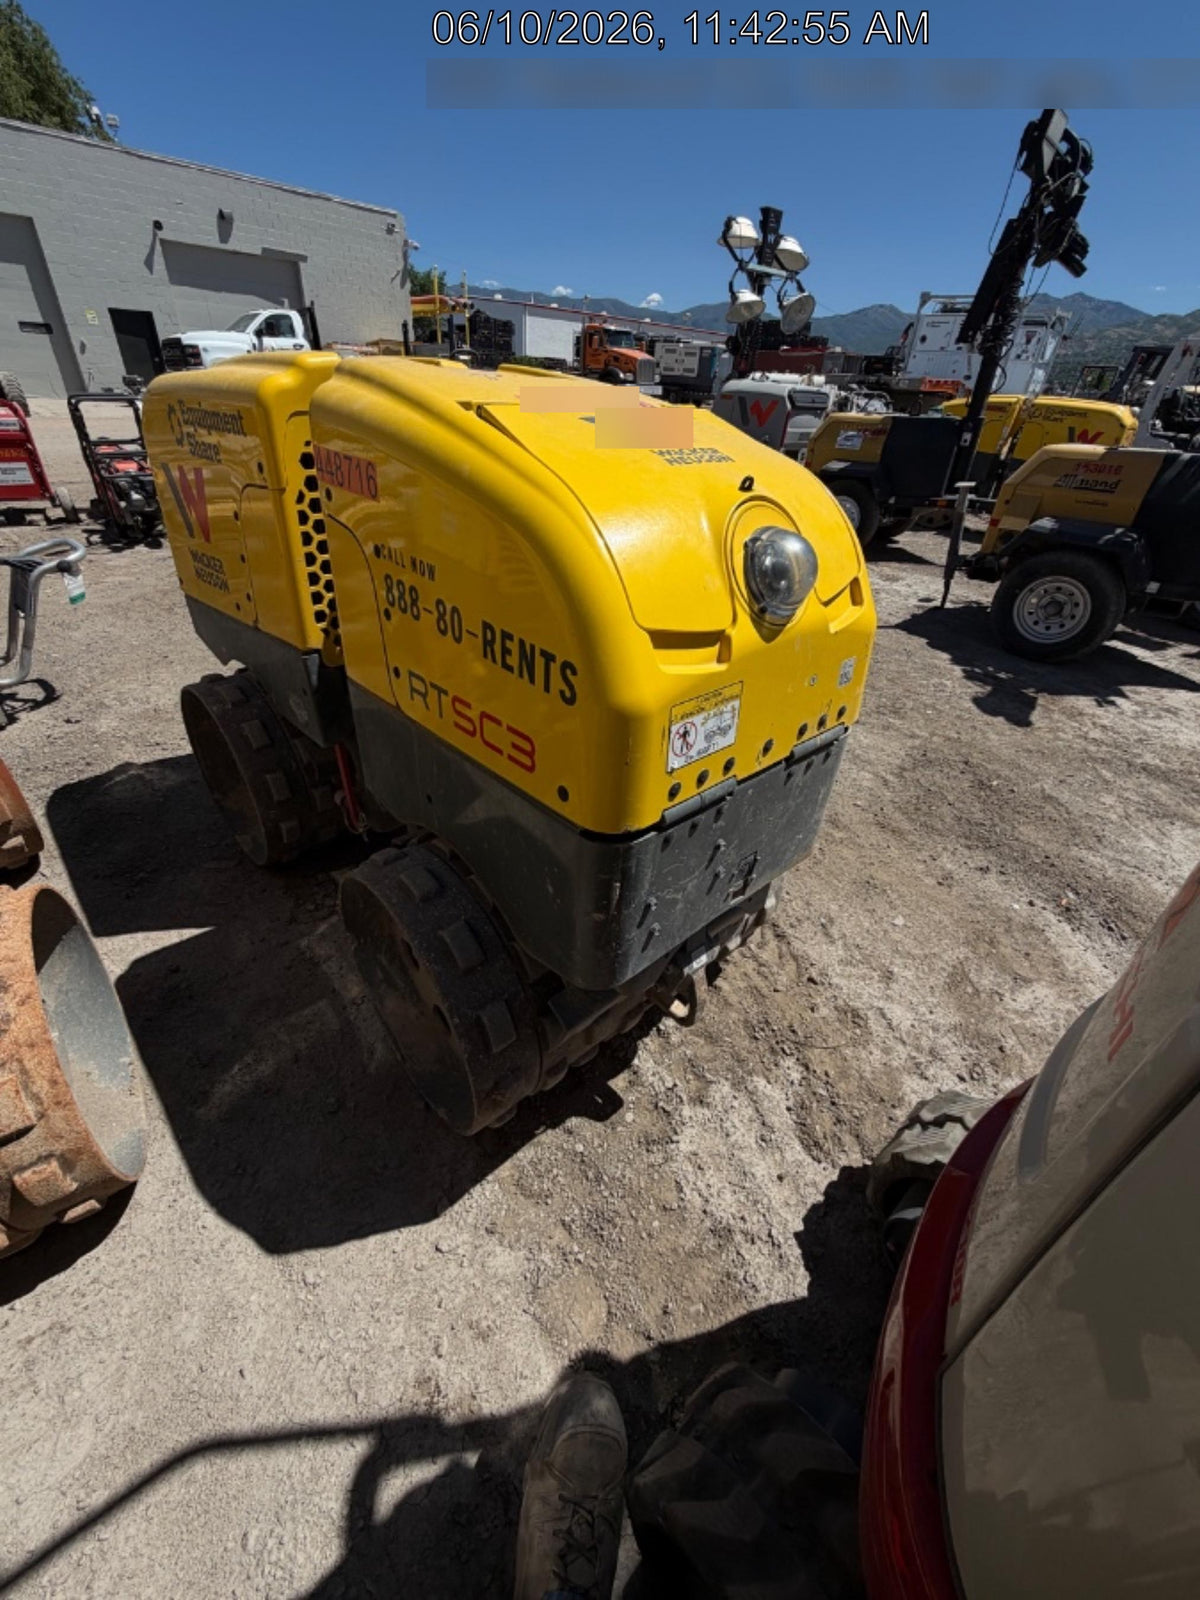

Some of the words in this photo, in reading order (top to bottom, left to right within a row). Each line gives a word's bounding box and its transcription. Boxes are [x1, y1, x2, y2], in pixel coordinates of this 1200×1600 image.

[179, 400, 246, 437] Equipment
[187, 431, 222, 464] Share
[381, 543, 406, 569] CALL
[410, 556, 436, 582] NOW
[384, 573, 579, 707] 888-80-RENTS
